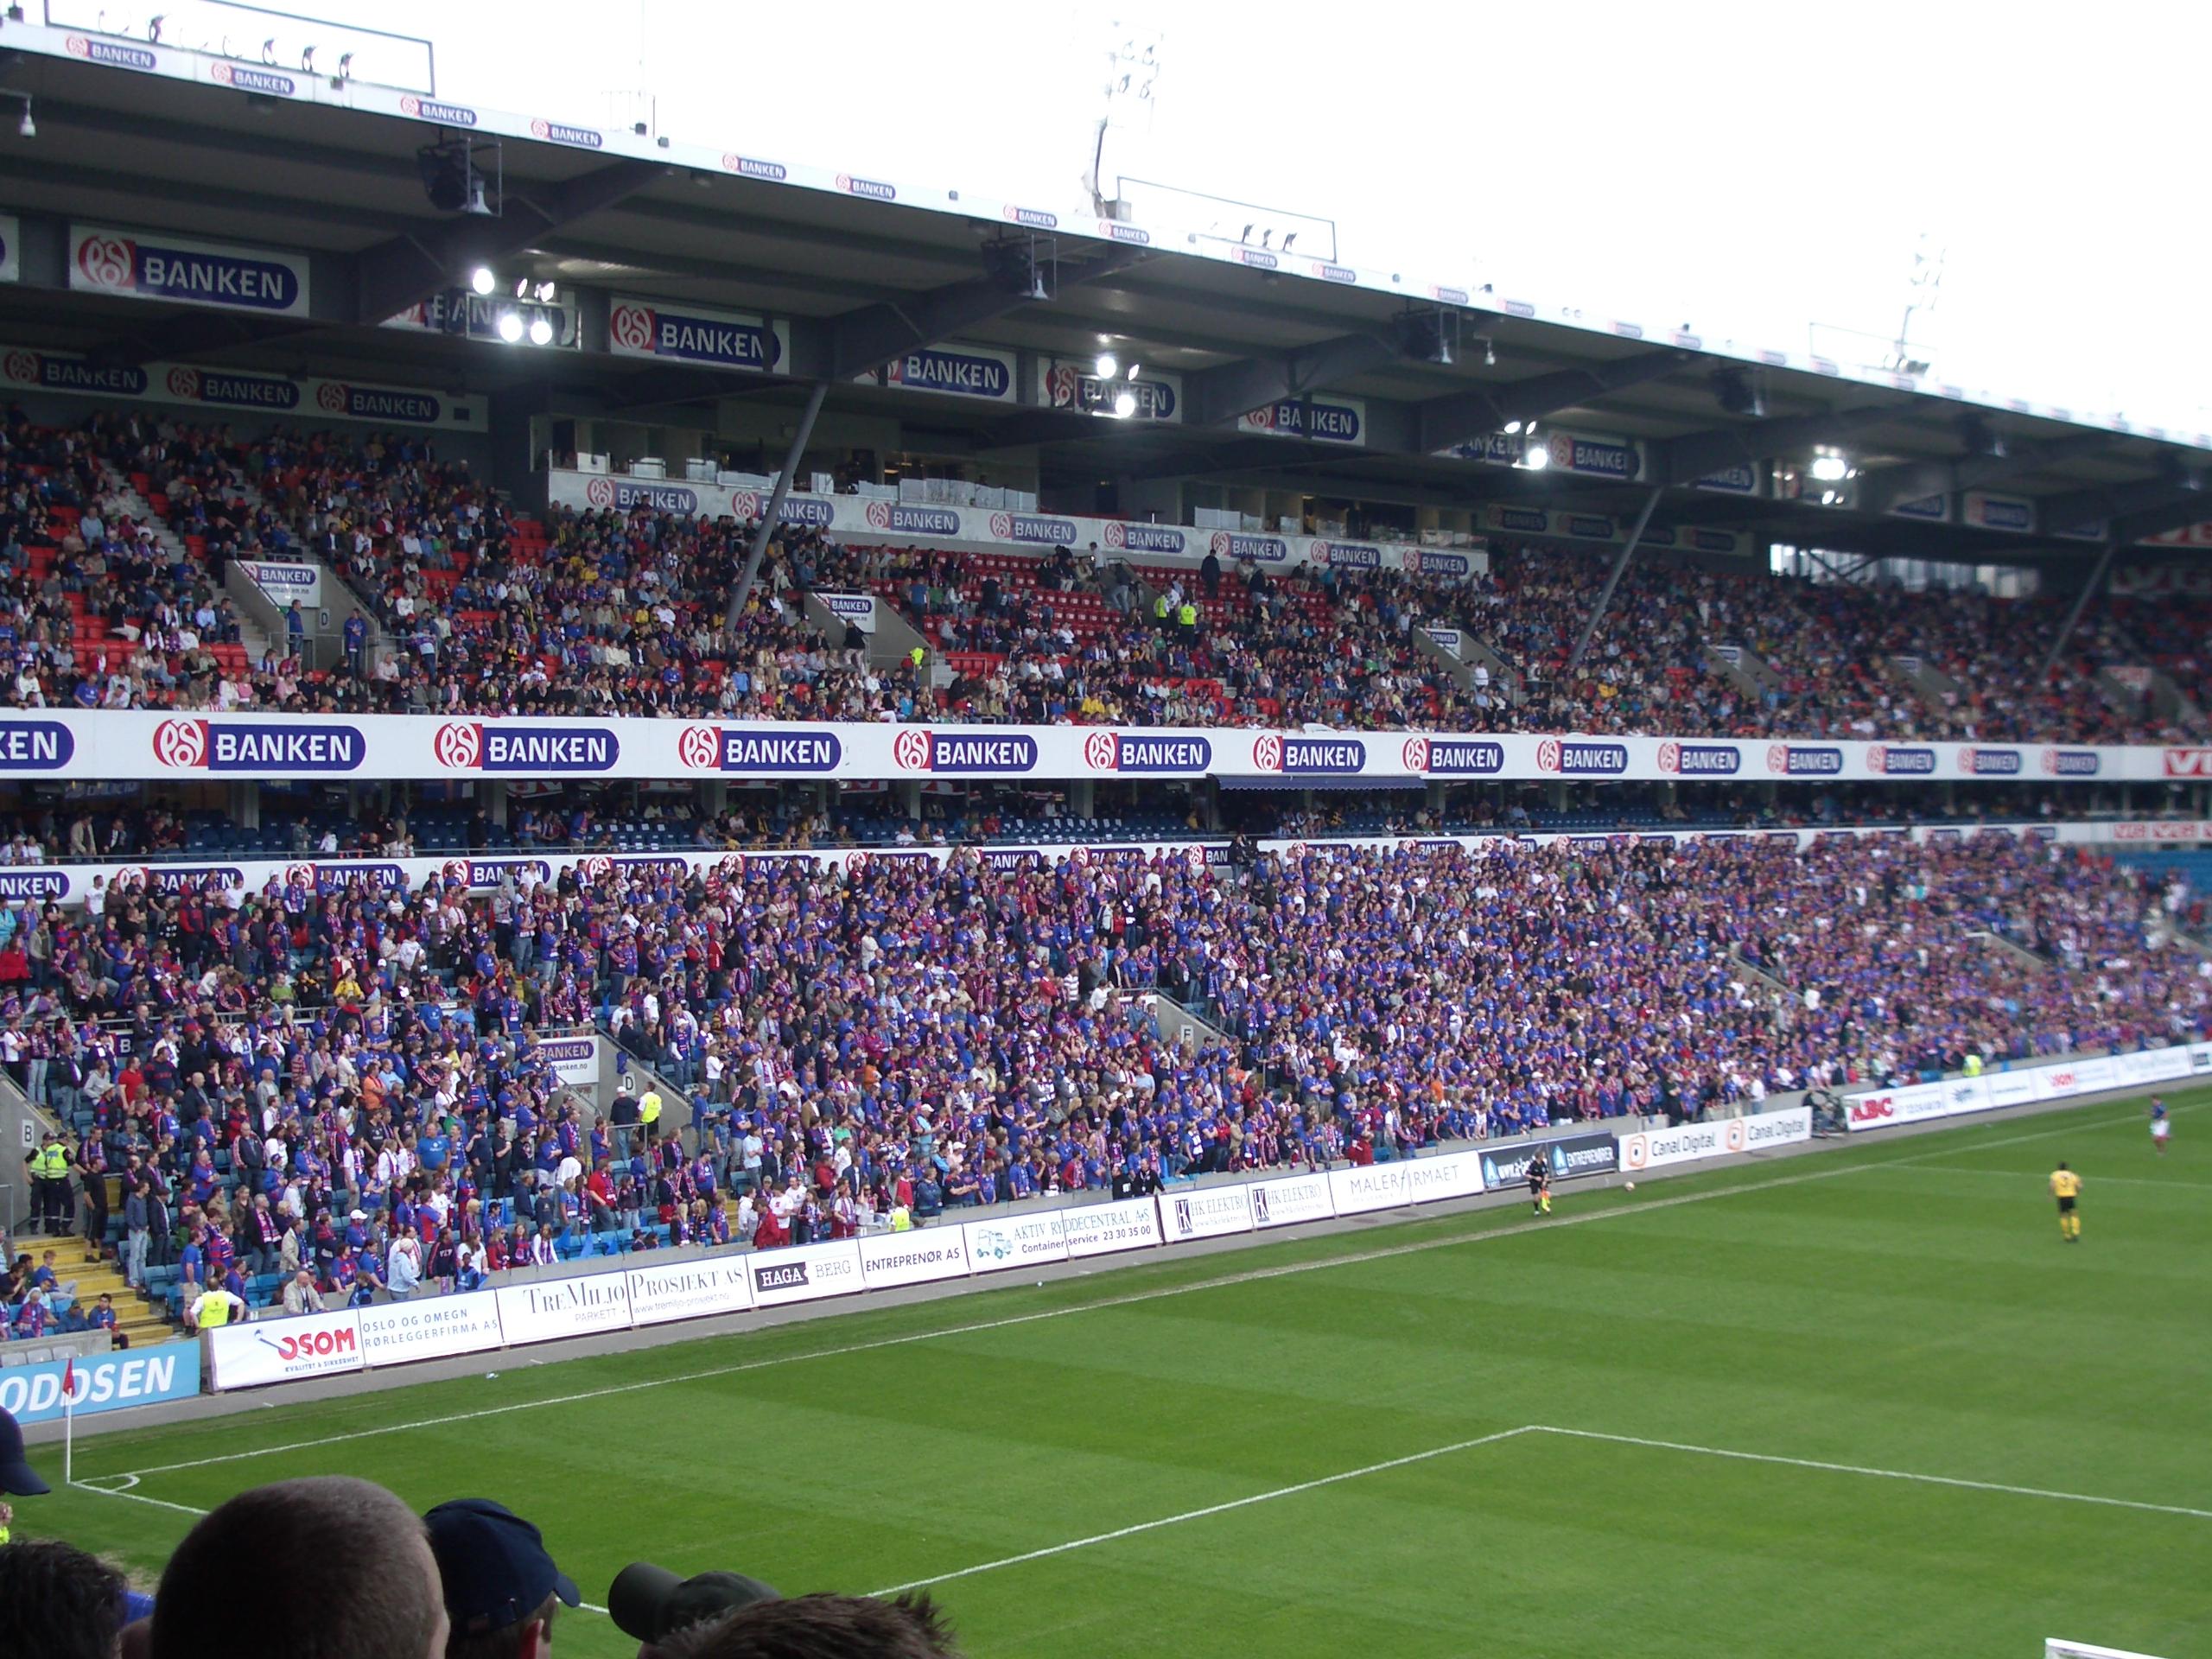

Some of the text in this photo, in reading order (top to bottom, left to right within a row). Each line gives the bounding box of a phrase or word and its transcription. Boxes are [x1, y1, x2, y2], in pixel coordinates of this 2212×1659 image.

[91, 43, 151, 67] BANKEN
[234, 69, 290, 92] BANKEN
[422, 103, 474, 125] BANKEN
[551, 126, 600, 148] BANKEN
[741, 158, 784, 180] BANKEN
[850, 180, 893, 200] BANKEN
[1018, 209, 1056, 228] BANKEN
[1112, 225, 1149, 244] BANKEN
[1245, 249, 1276, 268] BANKEN
[144, 257, 283, 300] BANKEN
[1324, 265, 1356, 283] BANKEN
[47, 363, 138, 389] BANKEN
[906, 355, 1000, 390] BANKEN
[207, 377, 292, 404] BANKEN
[353, 392, 431, 417] BANKEN
[893, 510, 955, 531] BANKEN
[1014, 520, 1072, 541] BANKEN
[1127, 531, 1180, 550] BANKEN
[1232, 539, 1282, 560] BANKEN
[1330, 548, 1378, 566] BANKEN
[1421, 556, 1468, 575] BANKEN
[261, 569, 312, 583] BANKEN
[832, 601, 869, 612] BANKEN
[321, 612, 327, 626] D
[216, 734, 353, 762] BANKEN
[488, 735, 607, 764] BANKEN
[727, 739, 831, 765] BANKEN
[937, 741, 1028, 765] BANKEN
[1122, 742, 1203, 766] BANKEN
[1286, 744, 1359, 767] BANKEN
[1432, 747, 1498, 768] BANKEN
[1562, 747, 1623, 768] BANKEN
[1681, 750, 1736, 770] BANKEN
[1789, 752, 1838, 771] BANKEN
[1886, 753, 1931, 772] BANKEN
[1975, 754, 2018, 772] BANKEN
[625, 1076, 634, 1091] D
[24, 1125, 33, 1142] B
[1748, 1119, 1805, 1141] Canal Digital
[1651, 1132, 1715, 1157] Canal Digital
[1268, 1184, 1321, 1205] HK ELEKTRO
[1190, 1195, 1249, 1217] HK ELEKTRO
[1014, 1223, 1046, 1241] AKTIV
[1051, 1212, 1132, 1236] RYDDECENTRAL
[1021, 1224, 1151, 1254] Container service 23 30 35 00
[866, 1248, 960, 1272] ENTREPRENØR AS
[630, 1270, 719, 1300] PROSJEKT
[727, 1267, 744, 1285] AS
[760, 1260, 851, 1287] HAGA BERG
[363, 1308, 468, 1333] OSLO OG OMEGN
[575, 1307, 617, 1324] PARKETT
[365, 1319, 499, 1348] RØRLEGGERFIRMA AS
